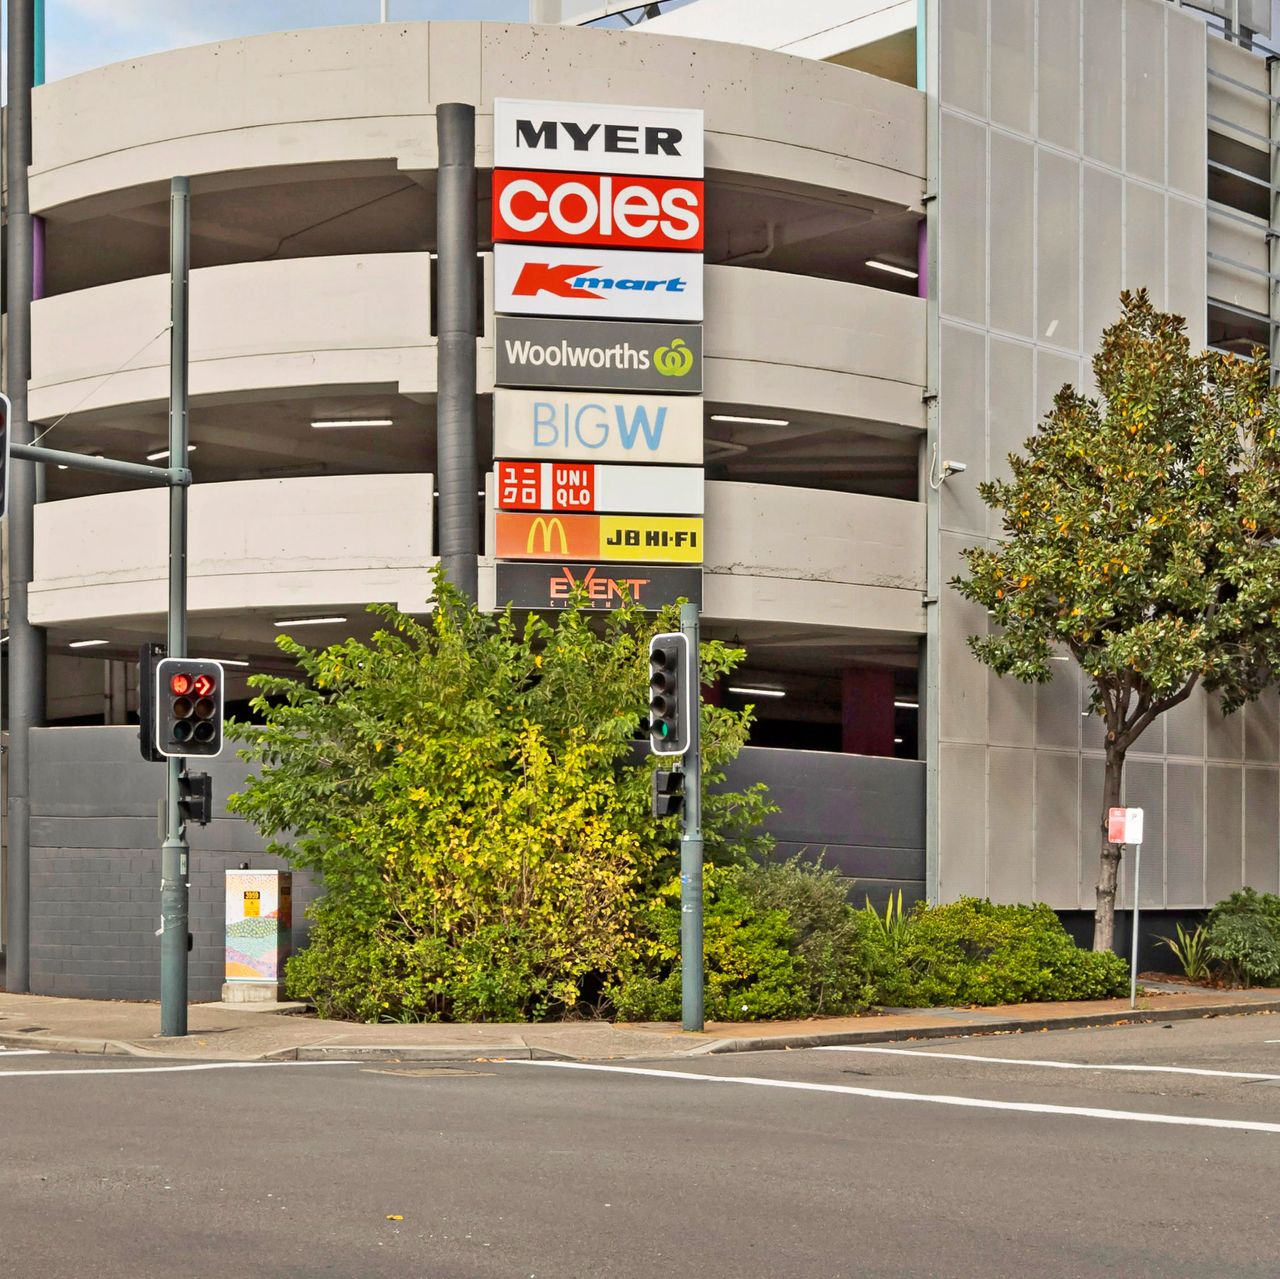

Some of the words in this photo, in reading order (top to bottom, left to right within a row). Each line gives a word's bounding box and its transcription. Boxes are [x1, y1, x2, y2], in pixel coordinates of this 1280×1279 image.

[516, 119, 683, 156] MYER
[499, 176, 700, 240] coles
[512, 262, 687, 300] Kmart
[505, 339, 651, 370] Woolworths
[606, 529, 640, 546] JB
[550, 567, 647, 599] EVENT
